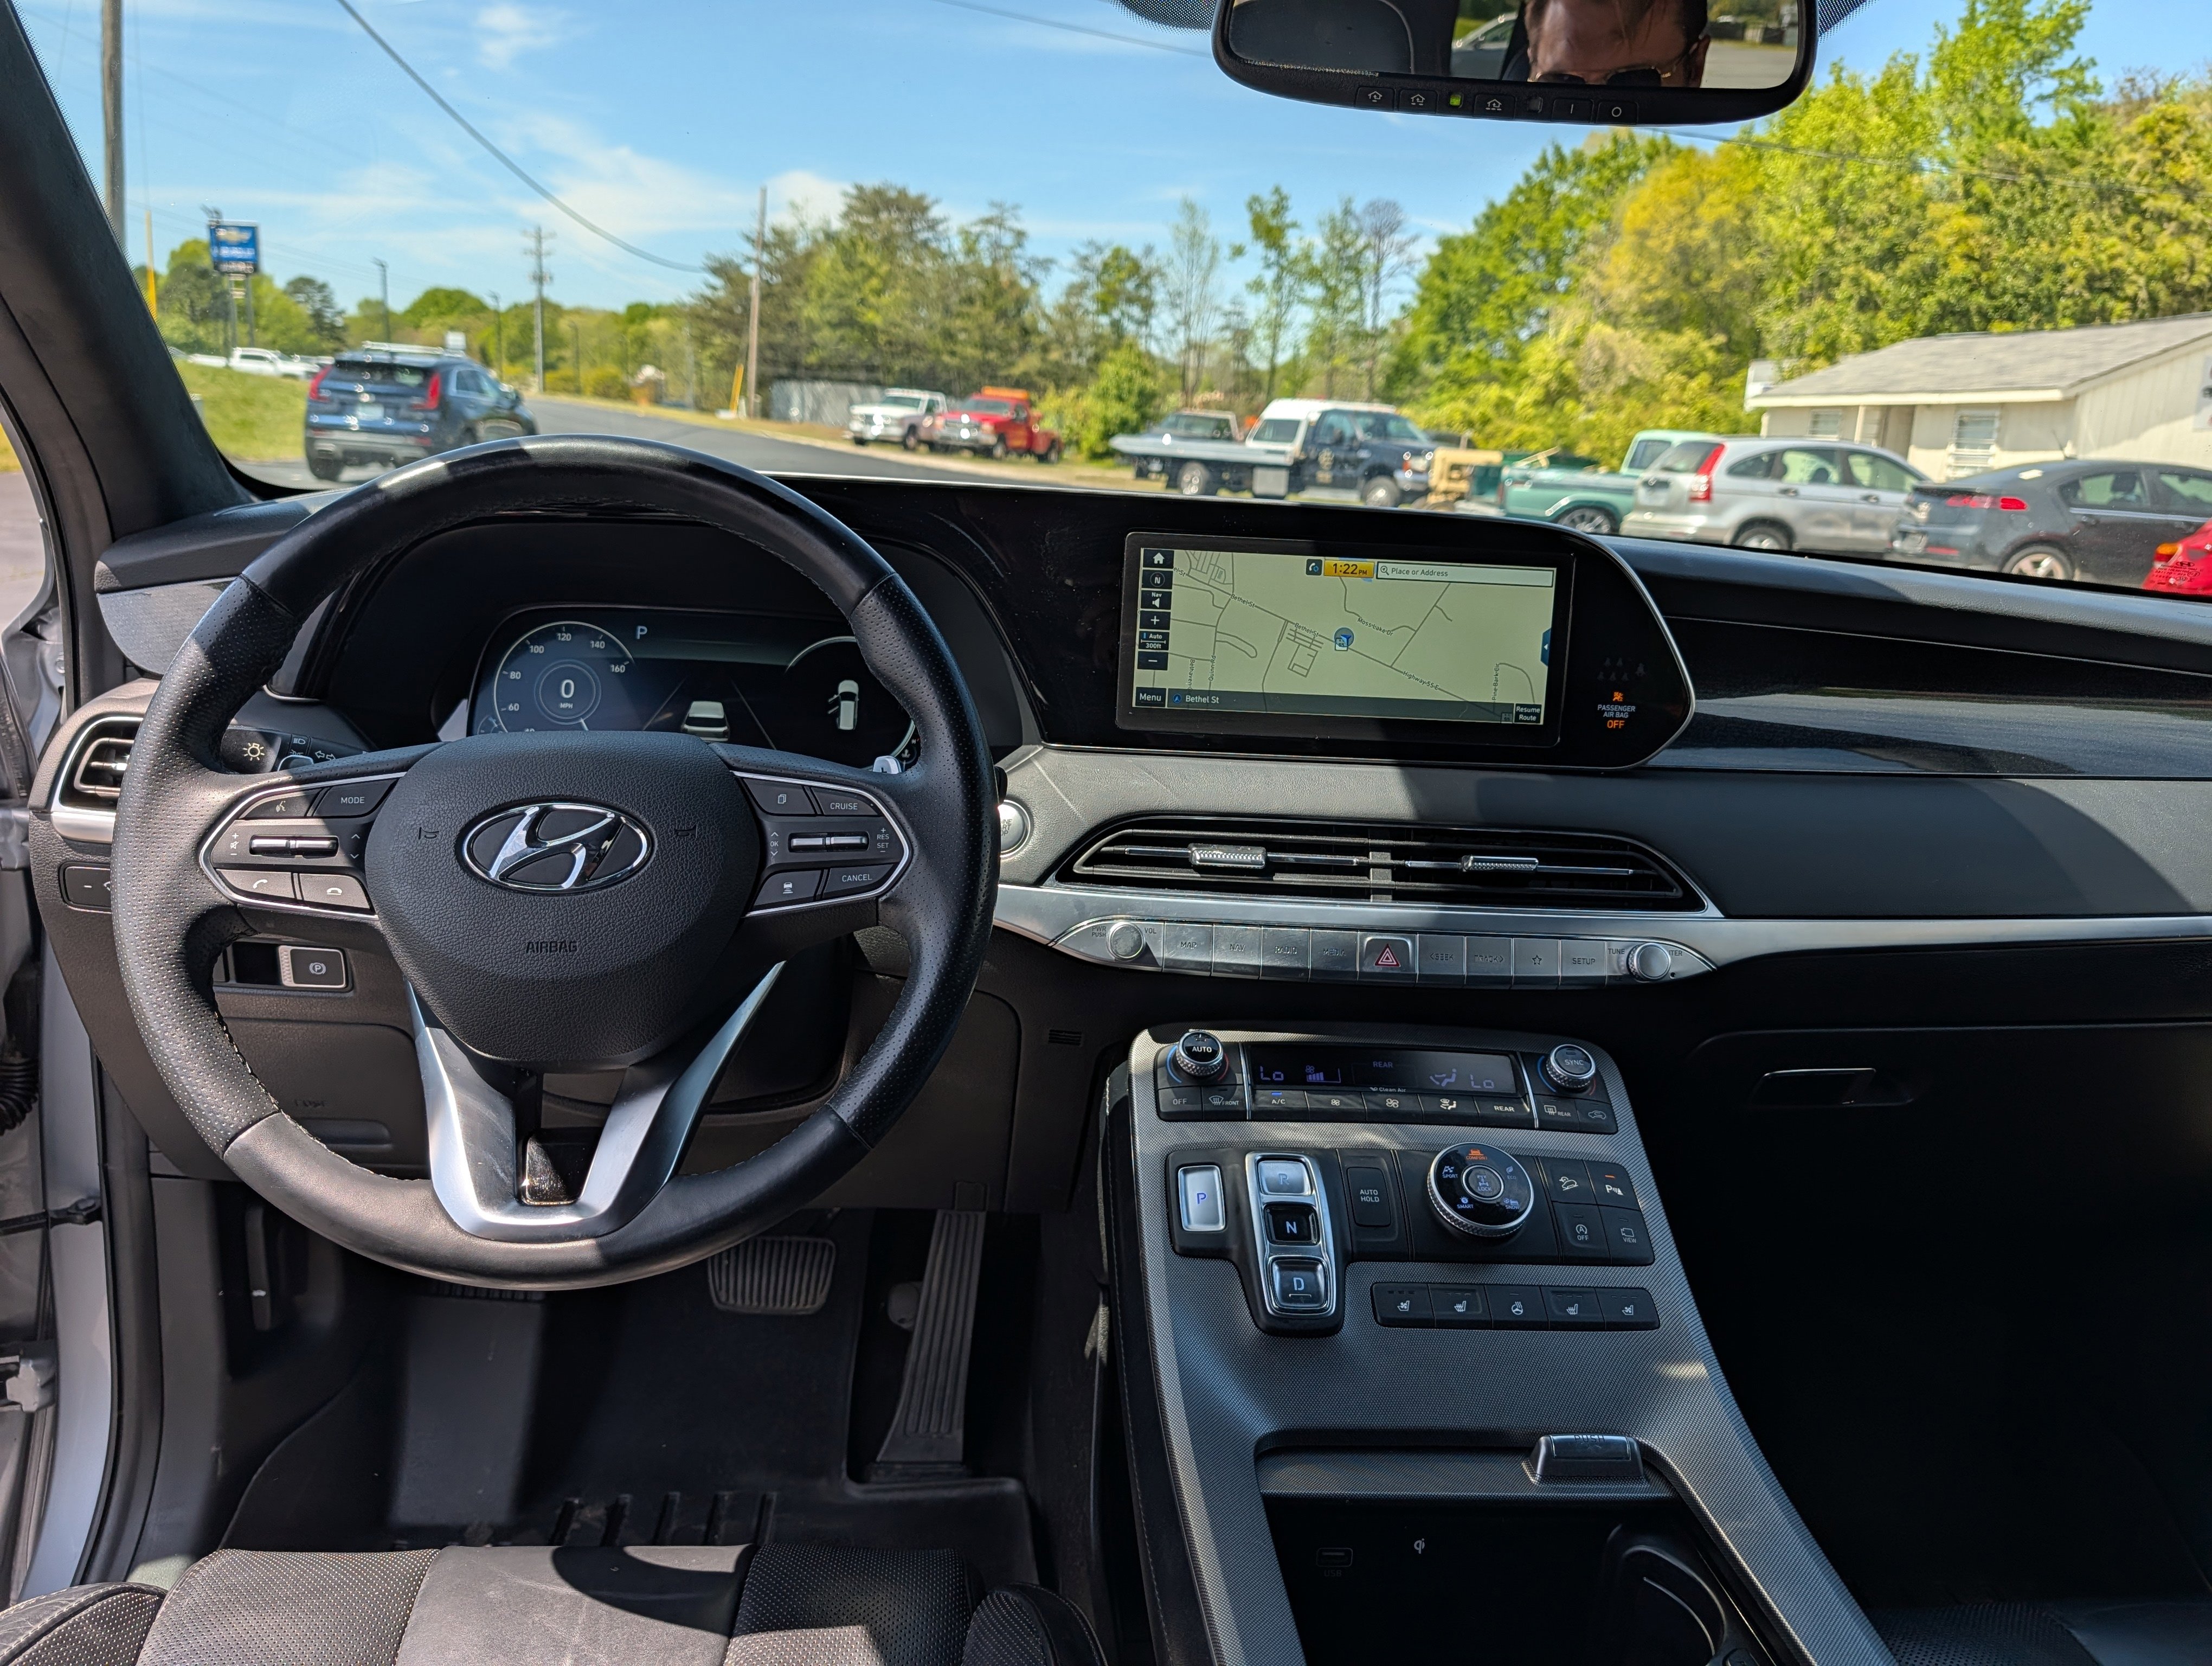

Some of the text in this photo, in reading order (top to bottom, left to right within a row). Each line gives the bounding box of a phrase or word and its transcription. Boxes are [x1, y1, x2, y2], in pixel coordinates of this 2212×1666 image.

[1333, 563, 1358, 575] 1:22
[1231, 593, 1248, 605] Bethel
[1295, 622, 1312, 634] Bethel
[1358, 618, 1372, 627] Moss
[1373, 624, 1386, 633] Lake
[557, 633, 571, 641] 120
[636, 626, 647, 639] P
[530, 645, 544, 653] 100
[590, 640, 605, 649] 140
[1210, 655, 1216, 663] Rd
[610, 664, 625, 673] 160
[510, 671, 521, 680] 80
[1403, 671, 1426, 685] Highway
[561, 679, 575, 699] 0
[1140, 693, 1161, 702] Menu
[1211, 696, 1219, 704] St
[508, 703, 519, 712] 60
[1607, 720, 1625, 728] OFF
[842, 874, 872, 882] CANCEL
[525, 940, 577, 954] AIRBAG
[1180, 941, 1198, 949] MAP
[1230, 943, 1245, 952] NAV
[1275, 946, 1297, 954] RADIO
[1323, 948, 1346, 957] MEDIA
[1278, 1173, 1289, 1185] R
[1197, 1193, 1207, 1204] P
[1286, 1221, 1297, 1234] N
[1293, 1277, 1304, 1291] D
